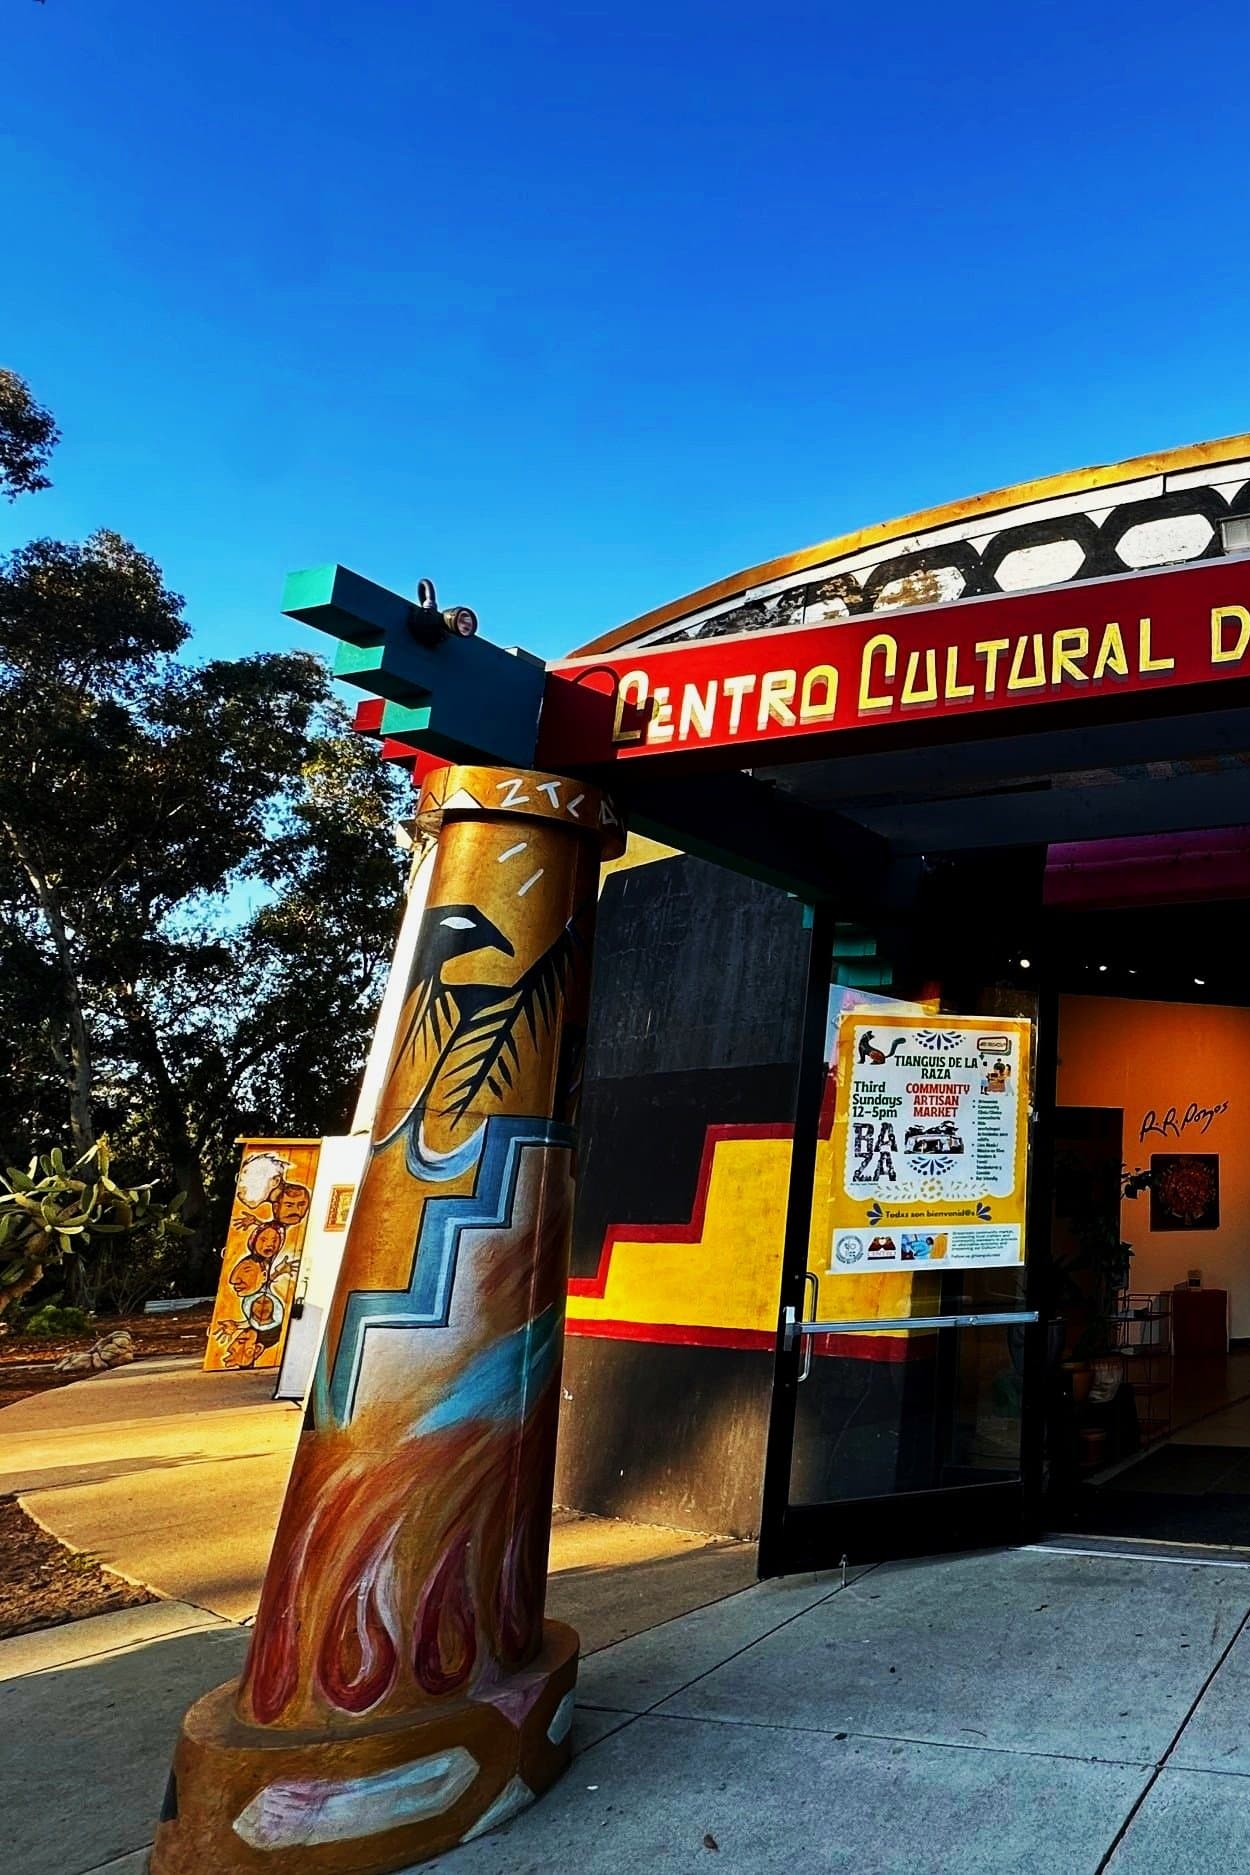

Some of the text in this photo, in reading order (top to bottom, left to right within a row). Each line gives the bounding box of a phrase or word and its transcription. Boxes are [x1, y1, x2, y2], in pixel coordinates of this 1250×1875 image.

[611, 664, 839, 744] CENTRO
[858, 617, 1175, 715] CULTURAL
[895, 1055, 978, 1069] TIANGUIS DE LA
[921, 1068, 951, 1080] RAZA
[854, 1081, 886, 1093] Third
[905, 1083, 970, 1095] COMMUNITY
[852, 1094, 903, 1108] Sundays
[913, 1095, 960, 1106] ARTISAN
[913, 1106, 959, 1118] MARKET
